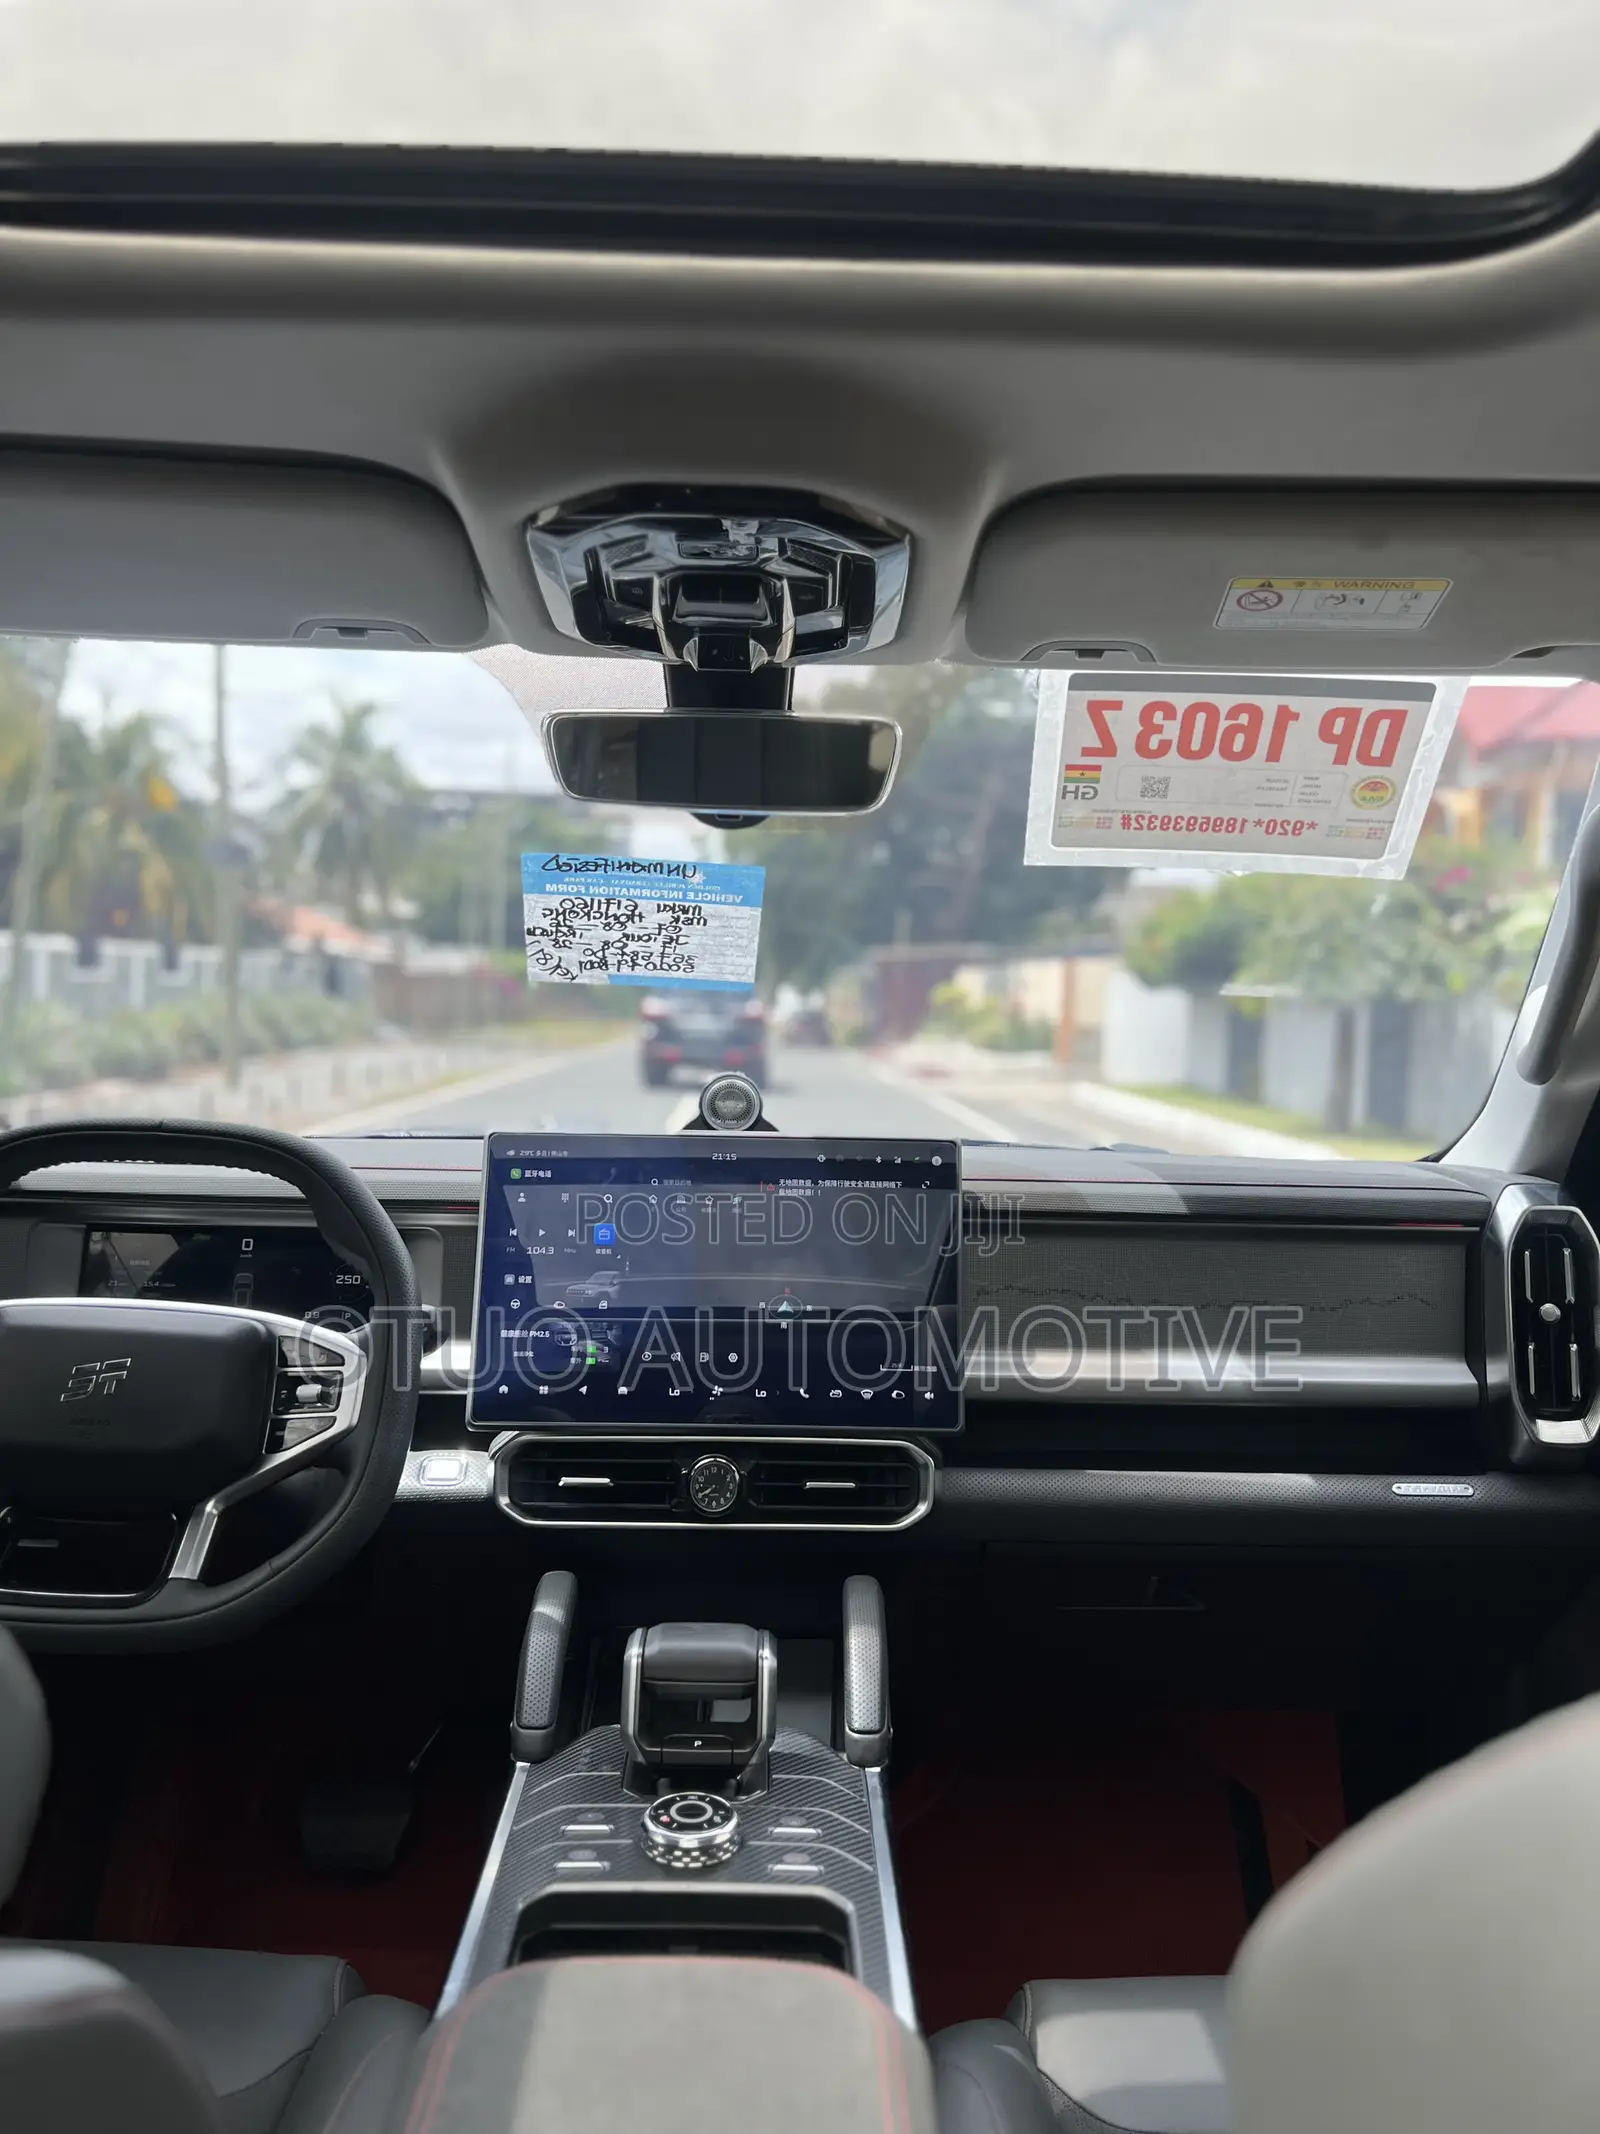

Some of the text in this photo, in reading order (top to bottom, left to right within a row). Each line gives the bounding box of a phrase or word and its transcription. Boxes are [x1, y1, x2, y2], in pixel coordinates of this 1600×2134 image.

[1333, 581, 1417, 590] WARNING
[711, 1152, 737, 1161] 21:15
[526, 1246, 555, 1256] 104.3
[335, 1274, 363, 1285] 250
[694, 1739, 703, 1748] P
